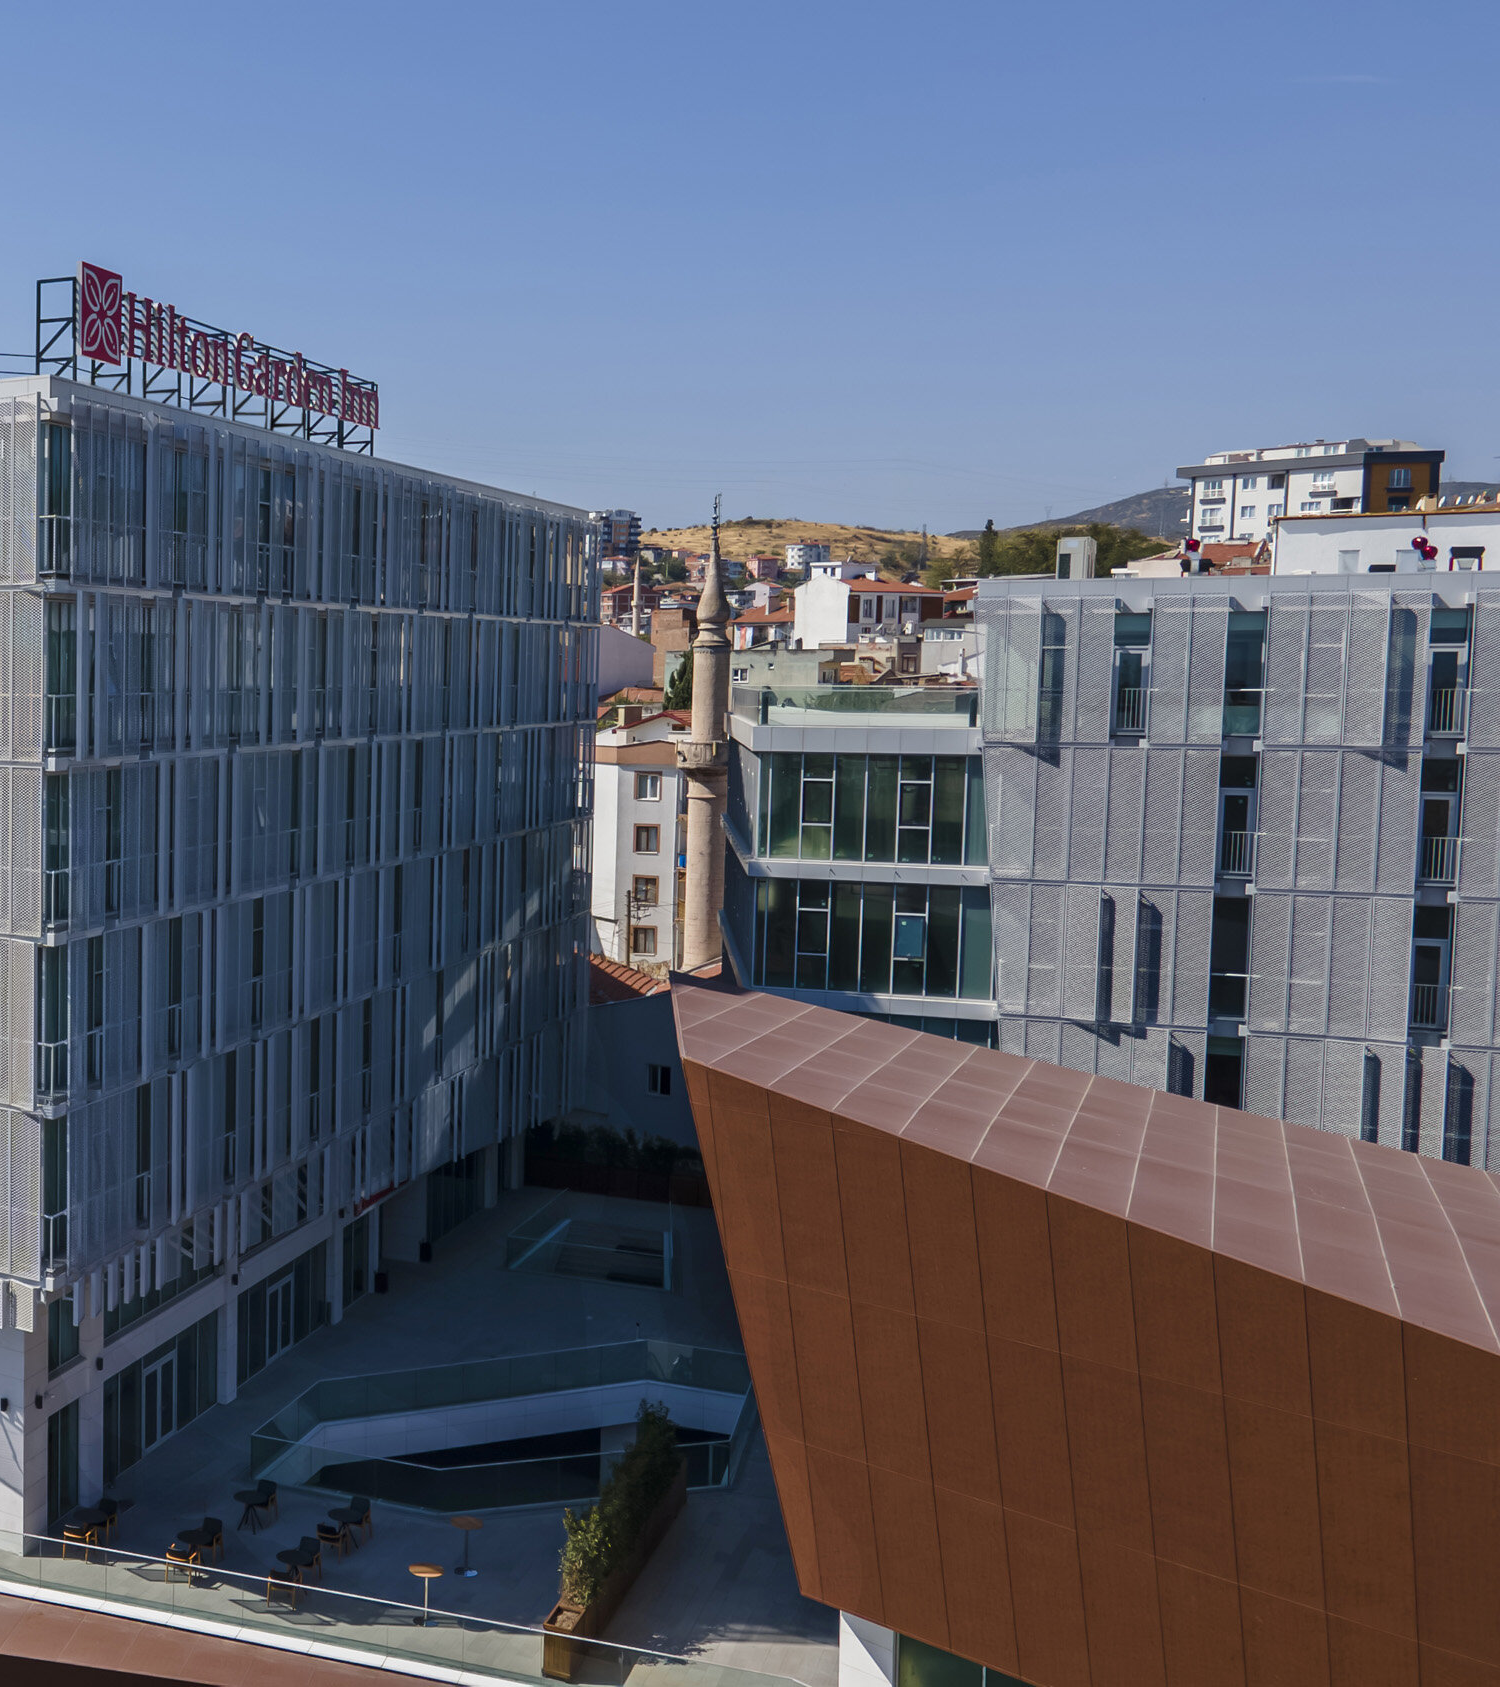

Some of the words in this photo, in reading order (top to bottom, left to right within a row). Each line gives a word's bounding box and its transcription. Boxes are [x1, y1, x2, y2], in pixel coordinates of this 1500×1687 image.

[122, 291, 233, 386] Hilton
[234, 332, 333, 416] Garden
[339, 368, 380, 430] Inn
